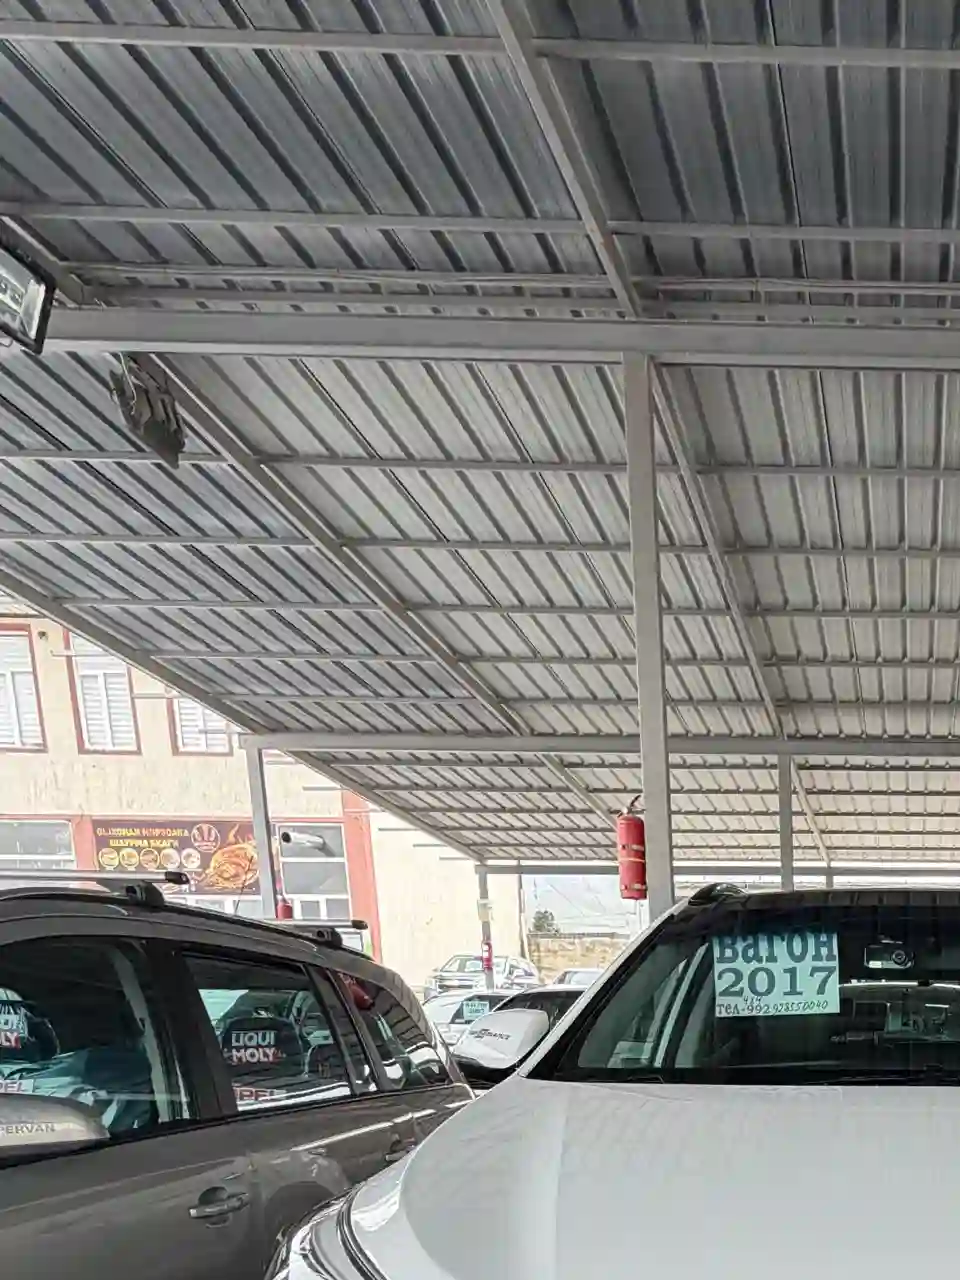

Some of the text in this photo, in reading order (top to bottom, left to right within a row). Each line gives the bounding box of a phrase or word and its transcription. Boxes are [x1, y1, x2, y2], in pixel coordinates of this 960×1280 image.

[716, 966, 837, 998] 2017
[231, 1031, 276, 1047] LIQUI
[231, 1047, 276, 1063] MOLY
